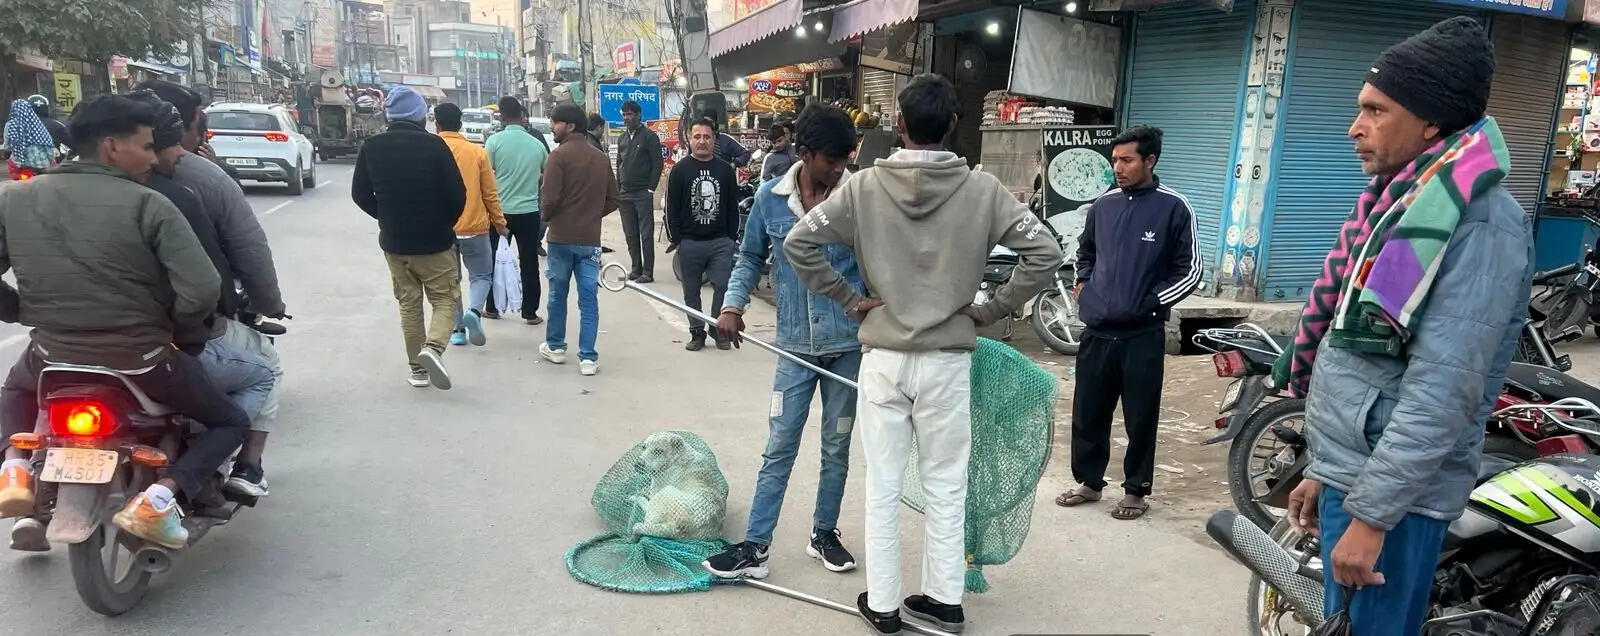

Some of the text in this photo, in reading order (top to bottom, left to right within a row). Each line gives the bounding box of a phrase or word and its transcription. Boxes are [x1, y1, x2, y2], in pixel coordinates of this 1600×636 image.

[603, 89, 656, 102] नगर परिषद
[1043, 130, 1092, 146] KALRA
[1096, 129, 1112, 137] EGG
